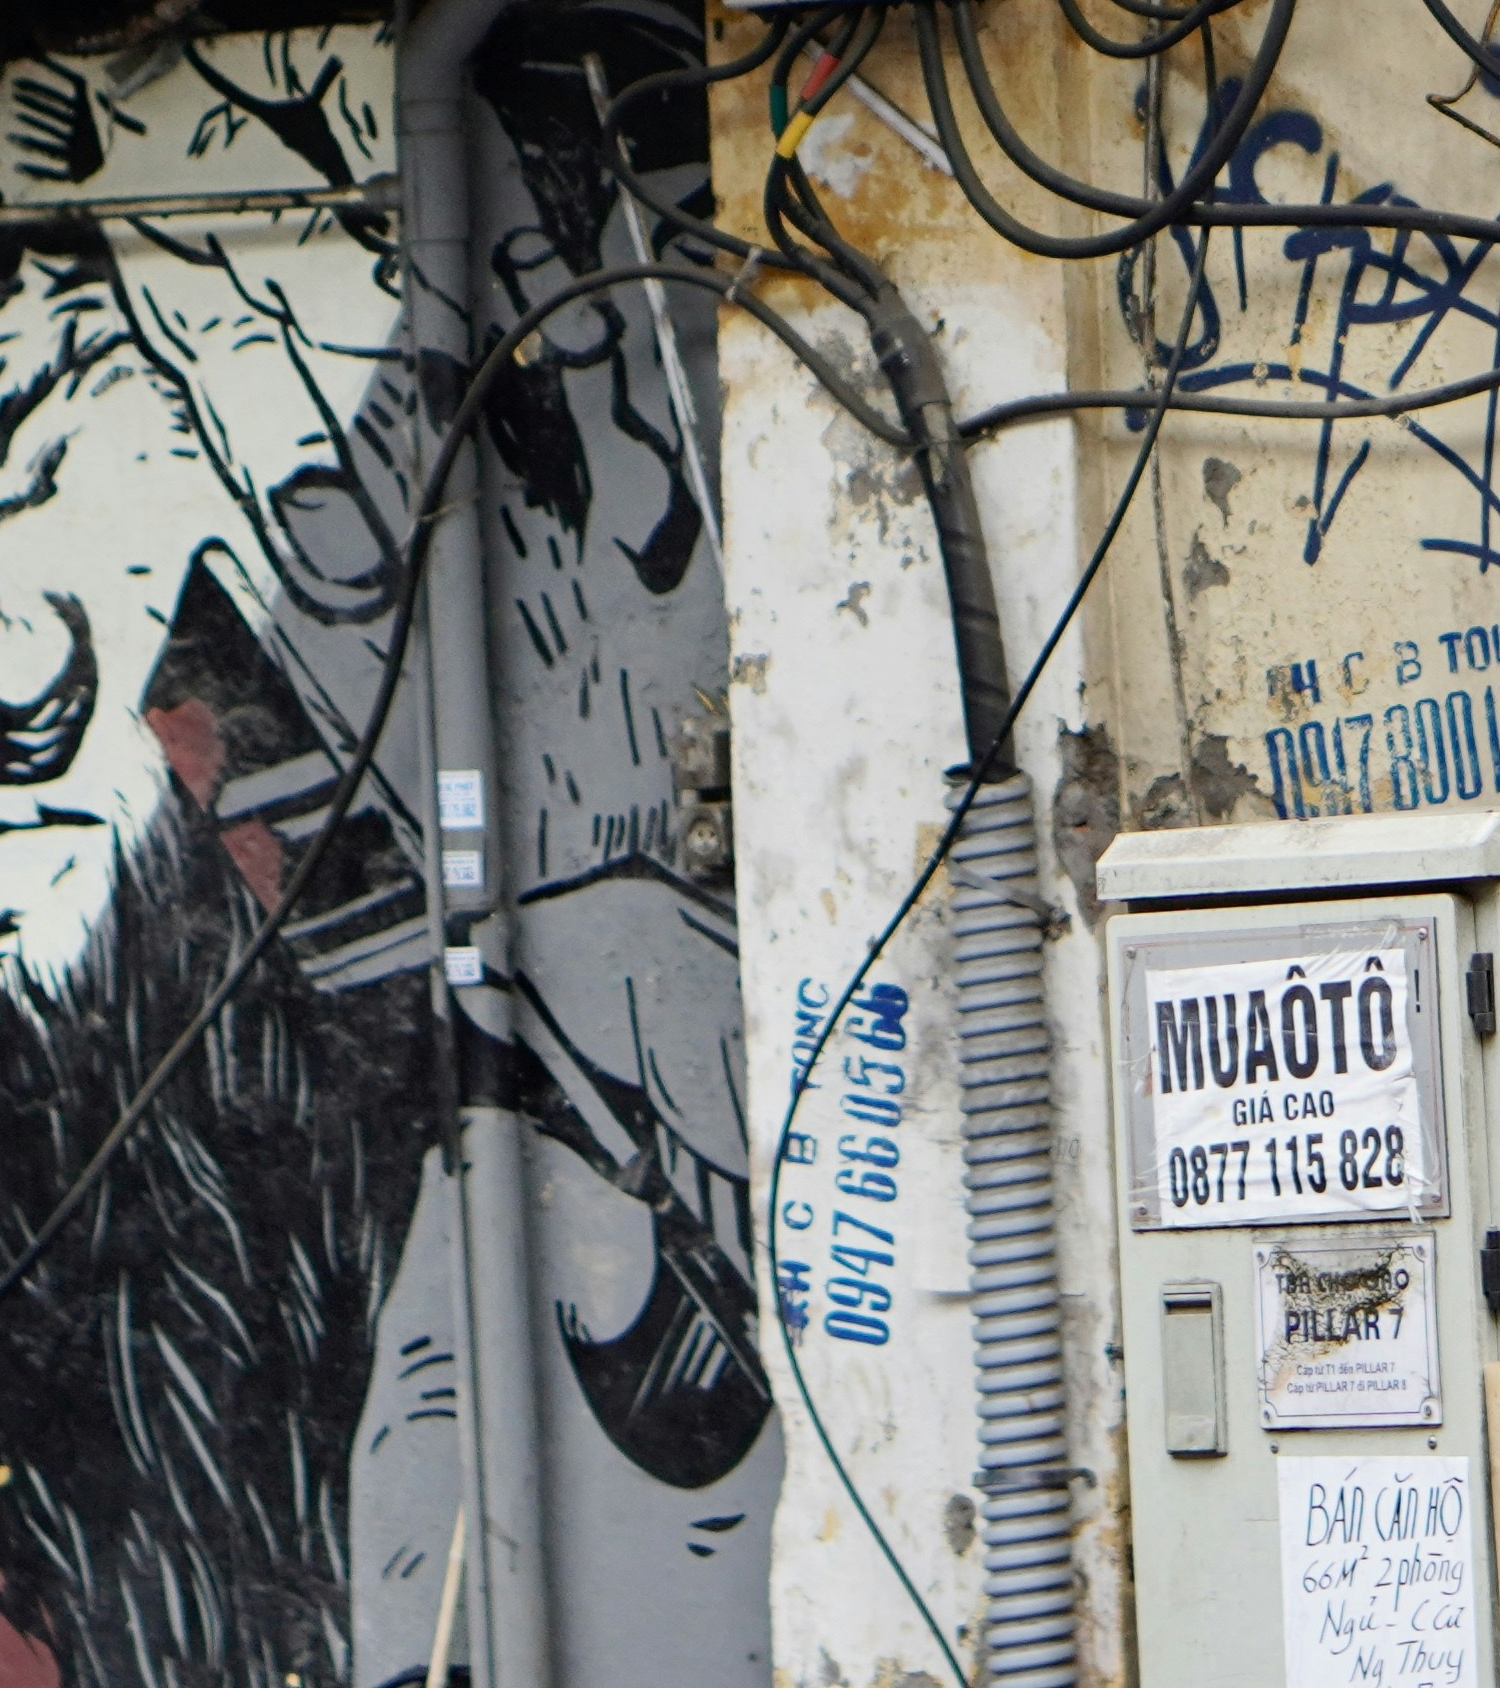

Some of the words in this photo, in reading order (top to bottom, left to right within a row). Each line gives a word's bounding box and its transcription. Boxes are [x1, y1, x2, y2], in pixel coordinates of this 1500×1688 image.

[1233, 1090, 1274, 1126] GIÁ
[1284, 1090, 1335, 1121] CAO
[1169, 1140, 1250, 1208] 0877
[1265, 1133, 1327, 1197] 115
[1339, 1125, 1404, 1191] 828
[1285, 1308, 1380, 1343] PILLAR
[1389, 1307, 1404, 1340] 7
[1316, 1381, 1348, 1393] PILLAR
[1367, 1379, 1400, 1392] PILLAR
[1356, 1362, 1389, 1374] PILLAR
[1306, 1466, 1364, 1546] BÁN
[1375, 1472, 1419, 1542] CĂN
[1425, 1476, 1464, 1543] HỘ
